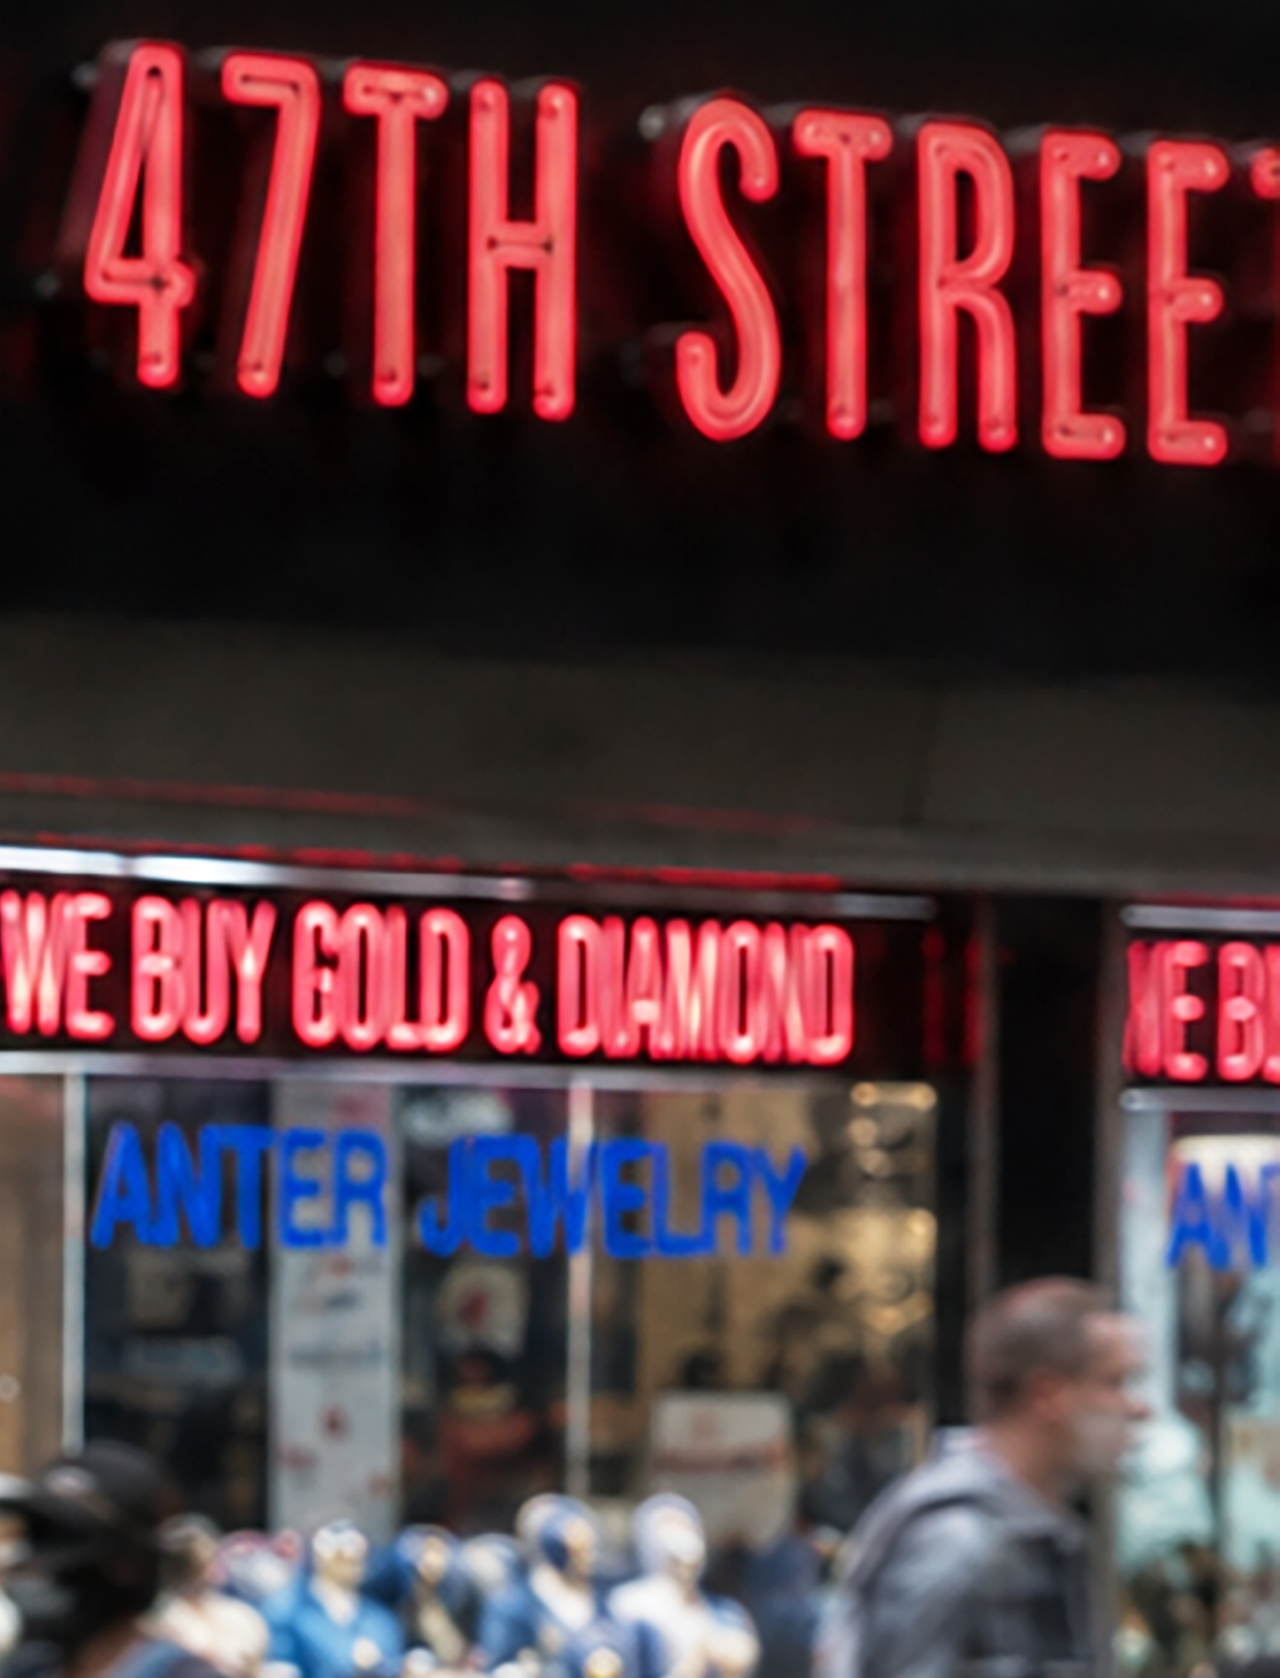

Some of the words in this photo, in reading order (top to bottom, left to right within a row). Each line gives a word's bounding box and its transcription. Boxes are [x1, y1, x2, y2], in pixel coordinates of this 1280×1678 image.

[83, 39, 579, 422] 47TH
[674, 95, 1280, 467] STREE
[129, 895, 278, 1046] BUY
[290, 900, 472, 1054] GOLD
[482, 915, 542, 1056] &
[555, 914, 856, 1065] DIAMOND
[90, 1122, 390, 1252] ANTER
[416, 1130, 806, 1259] JEWELRY
